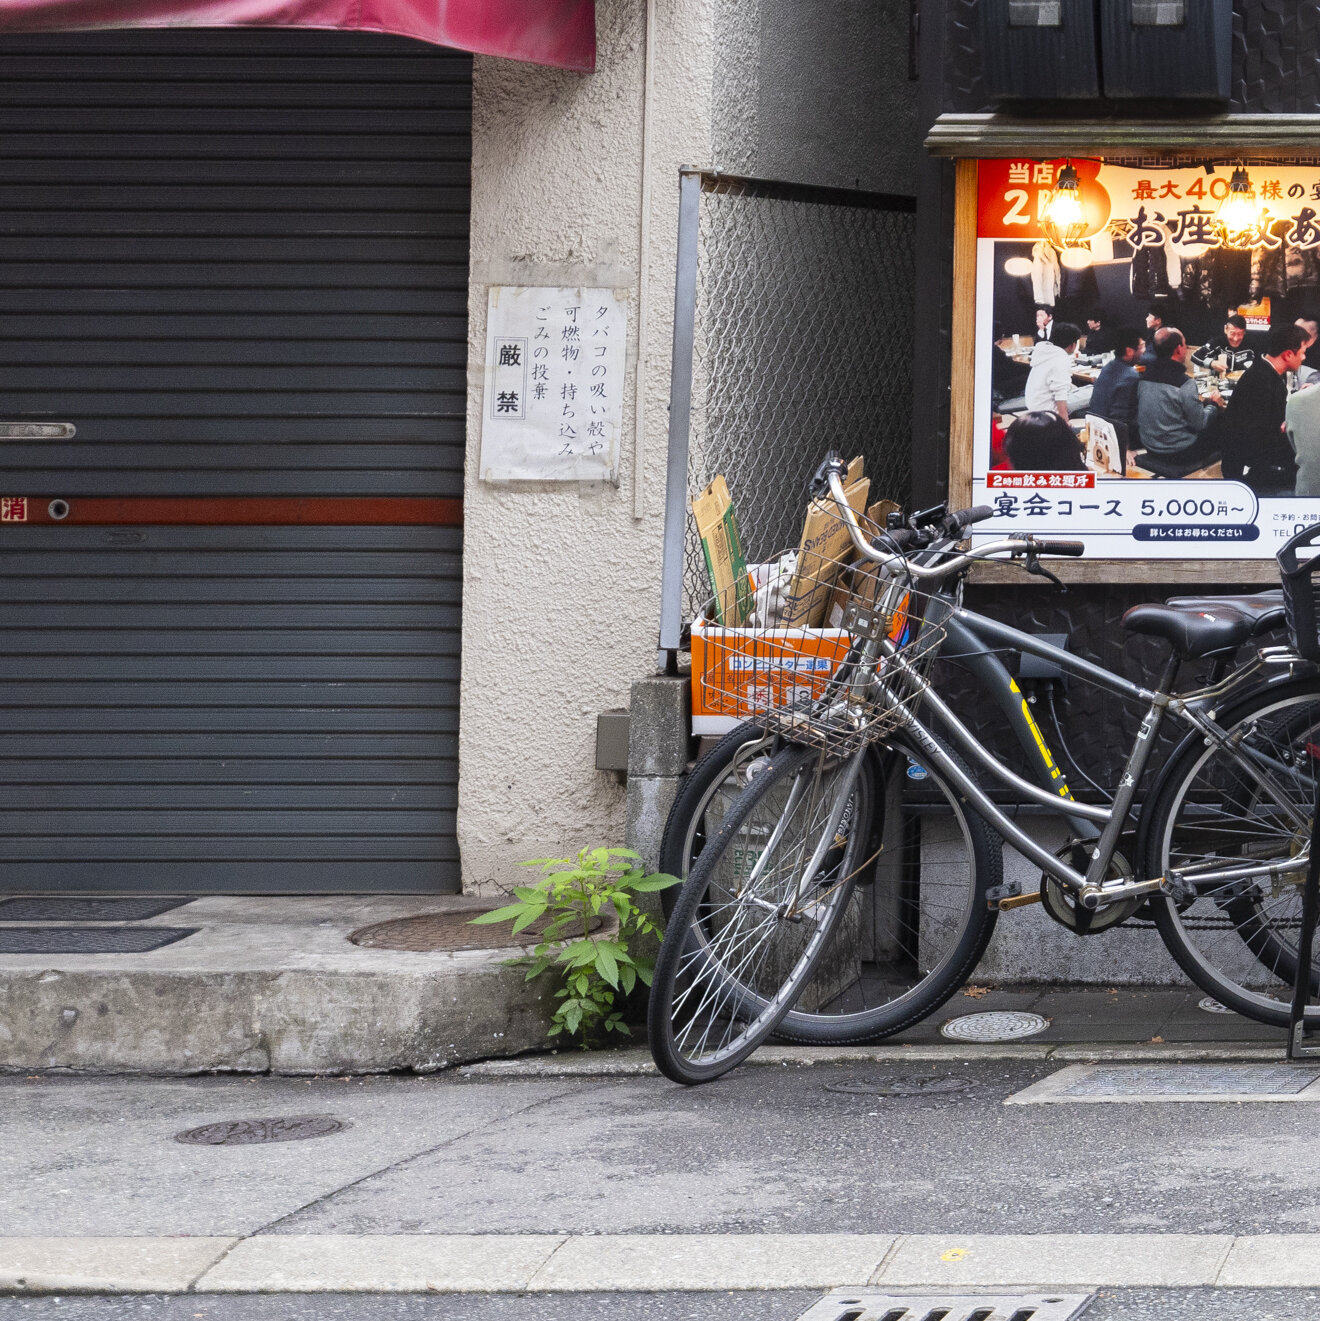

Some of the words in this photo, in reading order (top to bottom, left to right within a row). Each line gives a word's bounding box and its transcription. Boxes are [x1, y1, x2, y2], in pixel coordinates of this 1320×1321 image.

[531, 306, 551, 400] ごみの投棄
[496, 344, 522, 413] 厳禁
[558, 306, 581, 456] 可燃物・持ち込み
[587, 306, 608, 456] タバコの吸い殻や
[3, 498, 25, 519] 消
[994, 492, 1123, 519] 宴会コース
[1149, 527, 1243, 539] 詳しくはお尋ねください
[1273, 529, 1292, 537] TEL
